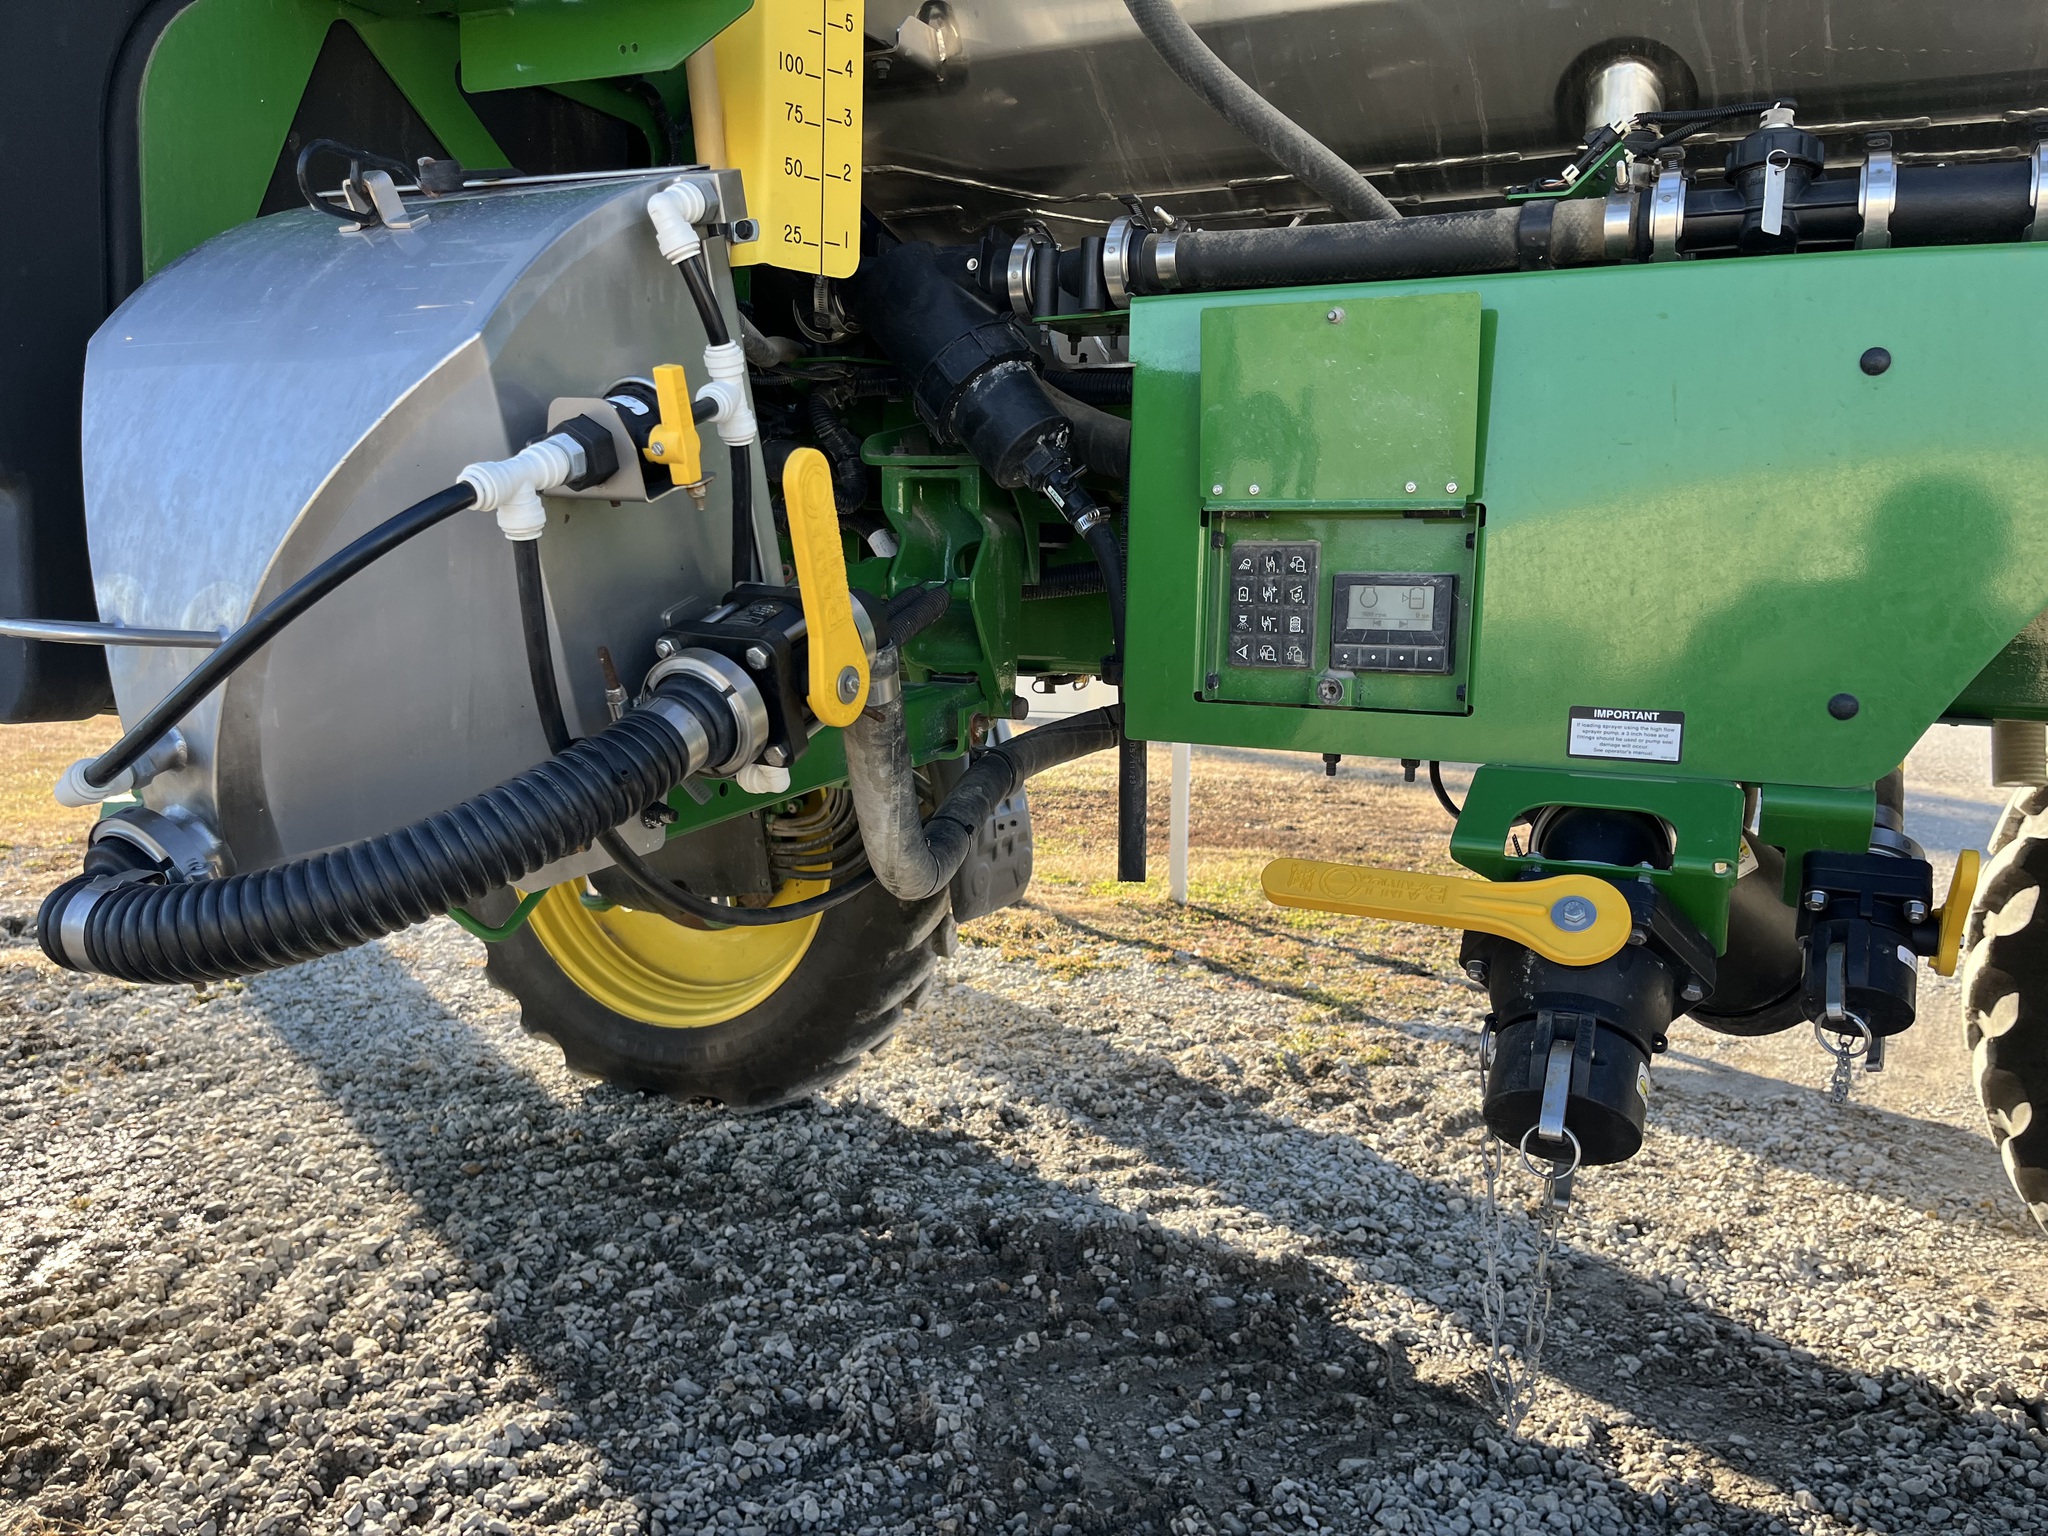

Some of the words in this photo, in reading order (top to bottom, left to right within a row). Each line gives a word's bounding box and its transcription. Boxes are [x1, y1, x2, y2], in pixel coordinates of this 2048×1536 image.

[845, 14, 854, 32] 5
[780, 51, 804, 75] 100
[844, 60, 854, 78] 4
[785, 102, 803, 123] 75
[843, 108, 853, 127] 3
[785, 157, 803, 177] 50
[843, 164, 852, 182] 2
[784, 225, 802, 243] 25
[844, 231, 849, 248] 1
[1594, 709, 1659, 720] IMPORTANT
